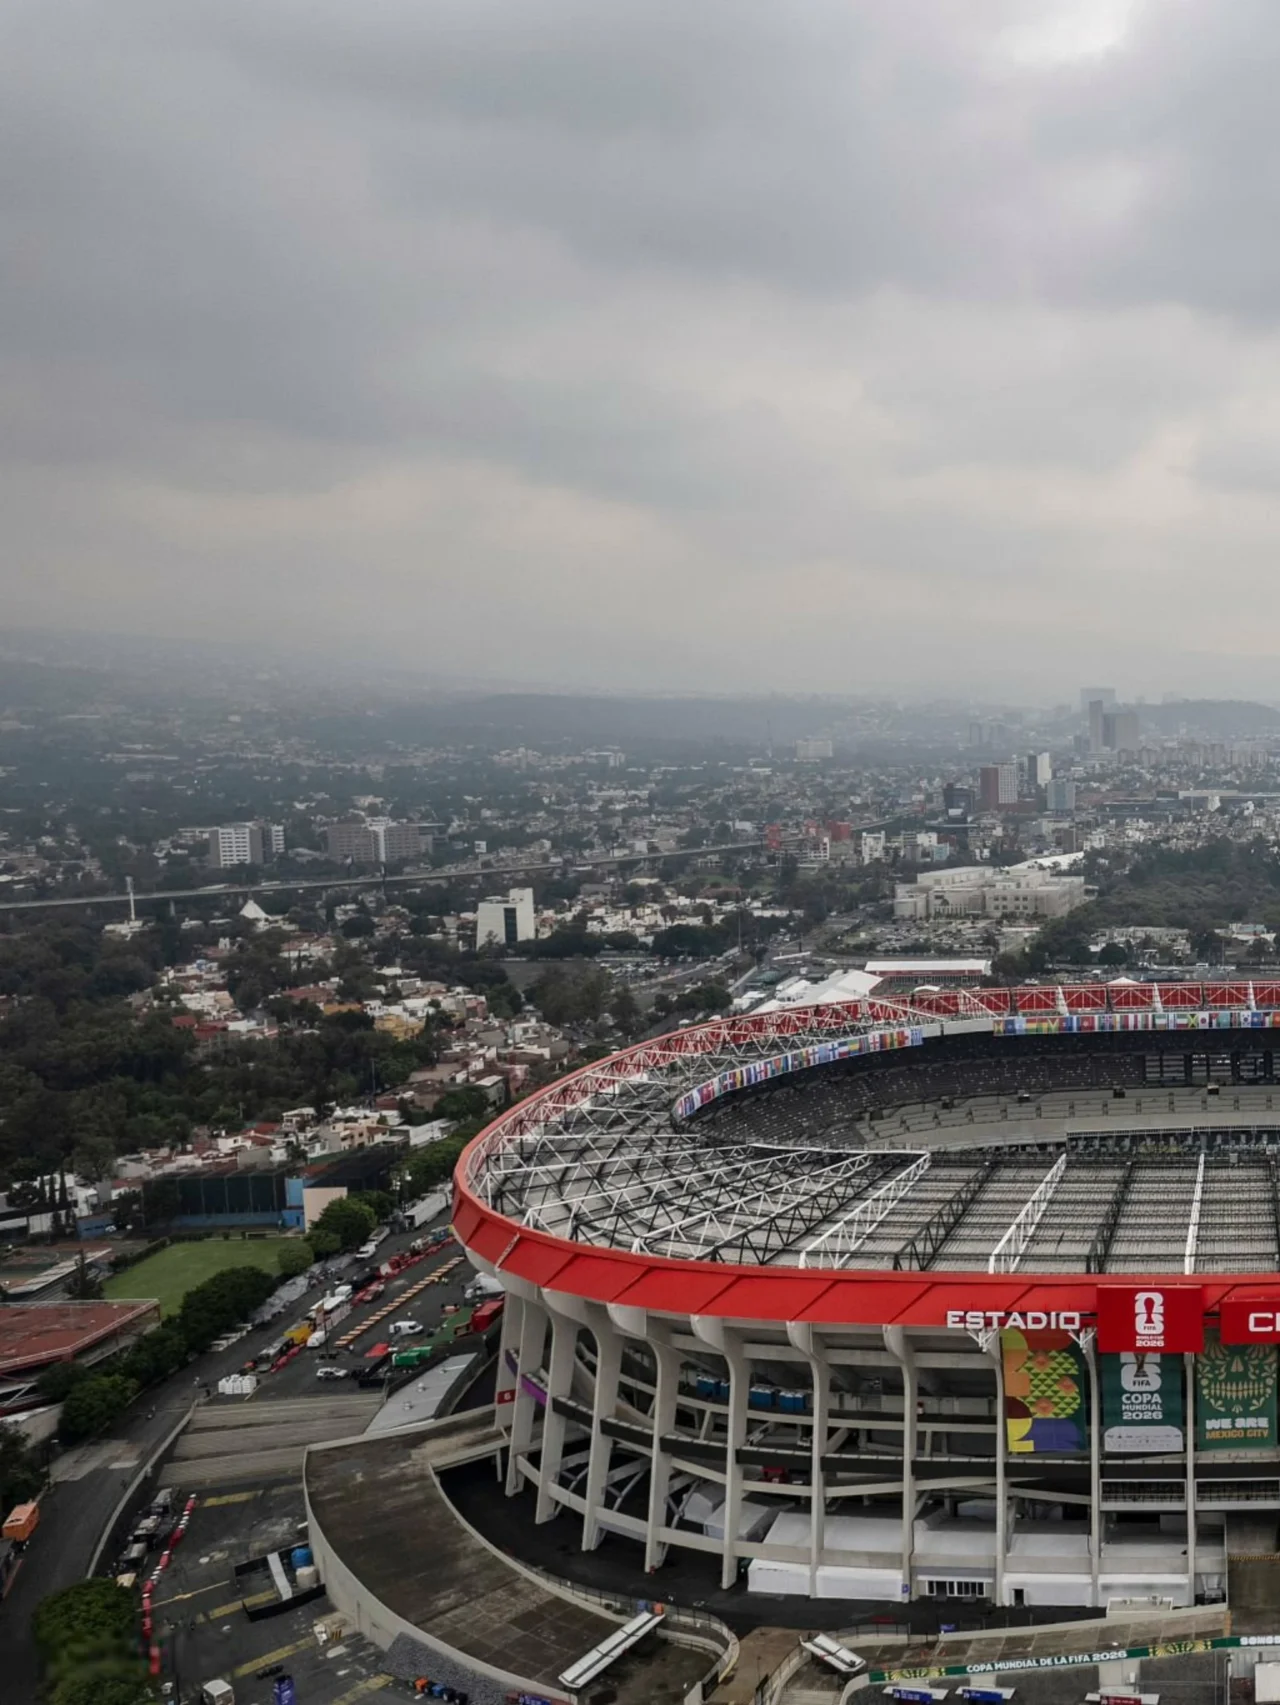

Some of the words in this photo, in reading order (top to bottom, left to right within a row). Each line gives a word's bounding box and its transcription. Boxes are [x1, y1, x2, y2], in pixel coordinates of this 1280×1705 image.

[946, 1310, 1081, 1330] ESTADIO
[1122, 1393, 1162, 1404] COPA
[1122, 1411, 1163, 1420] 2026
[1205, 1418, 1232, 1430] WE
[1235, 1417, 1269, 1428] ARE
[1246, 1429, 1269, 1437] CITY
[966, 1663, 994, 1673] COPA
[994, 1659, 1039, 1670] MUNDIAL
[1040, 1657, 1053, 1666] DE
[1054, 1655, 1068, 1665] LA
[1068, 1654, 1090, 1664] FIFA
[1091, 1650, 1128, 1662] 2026
